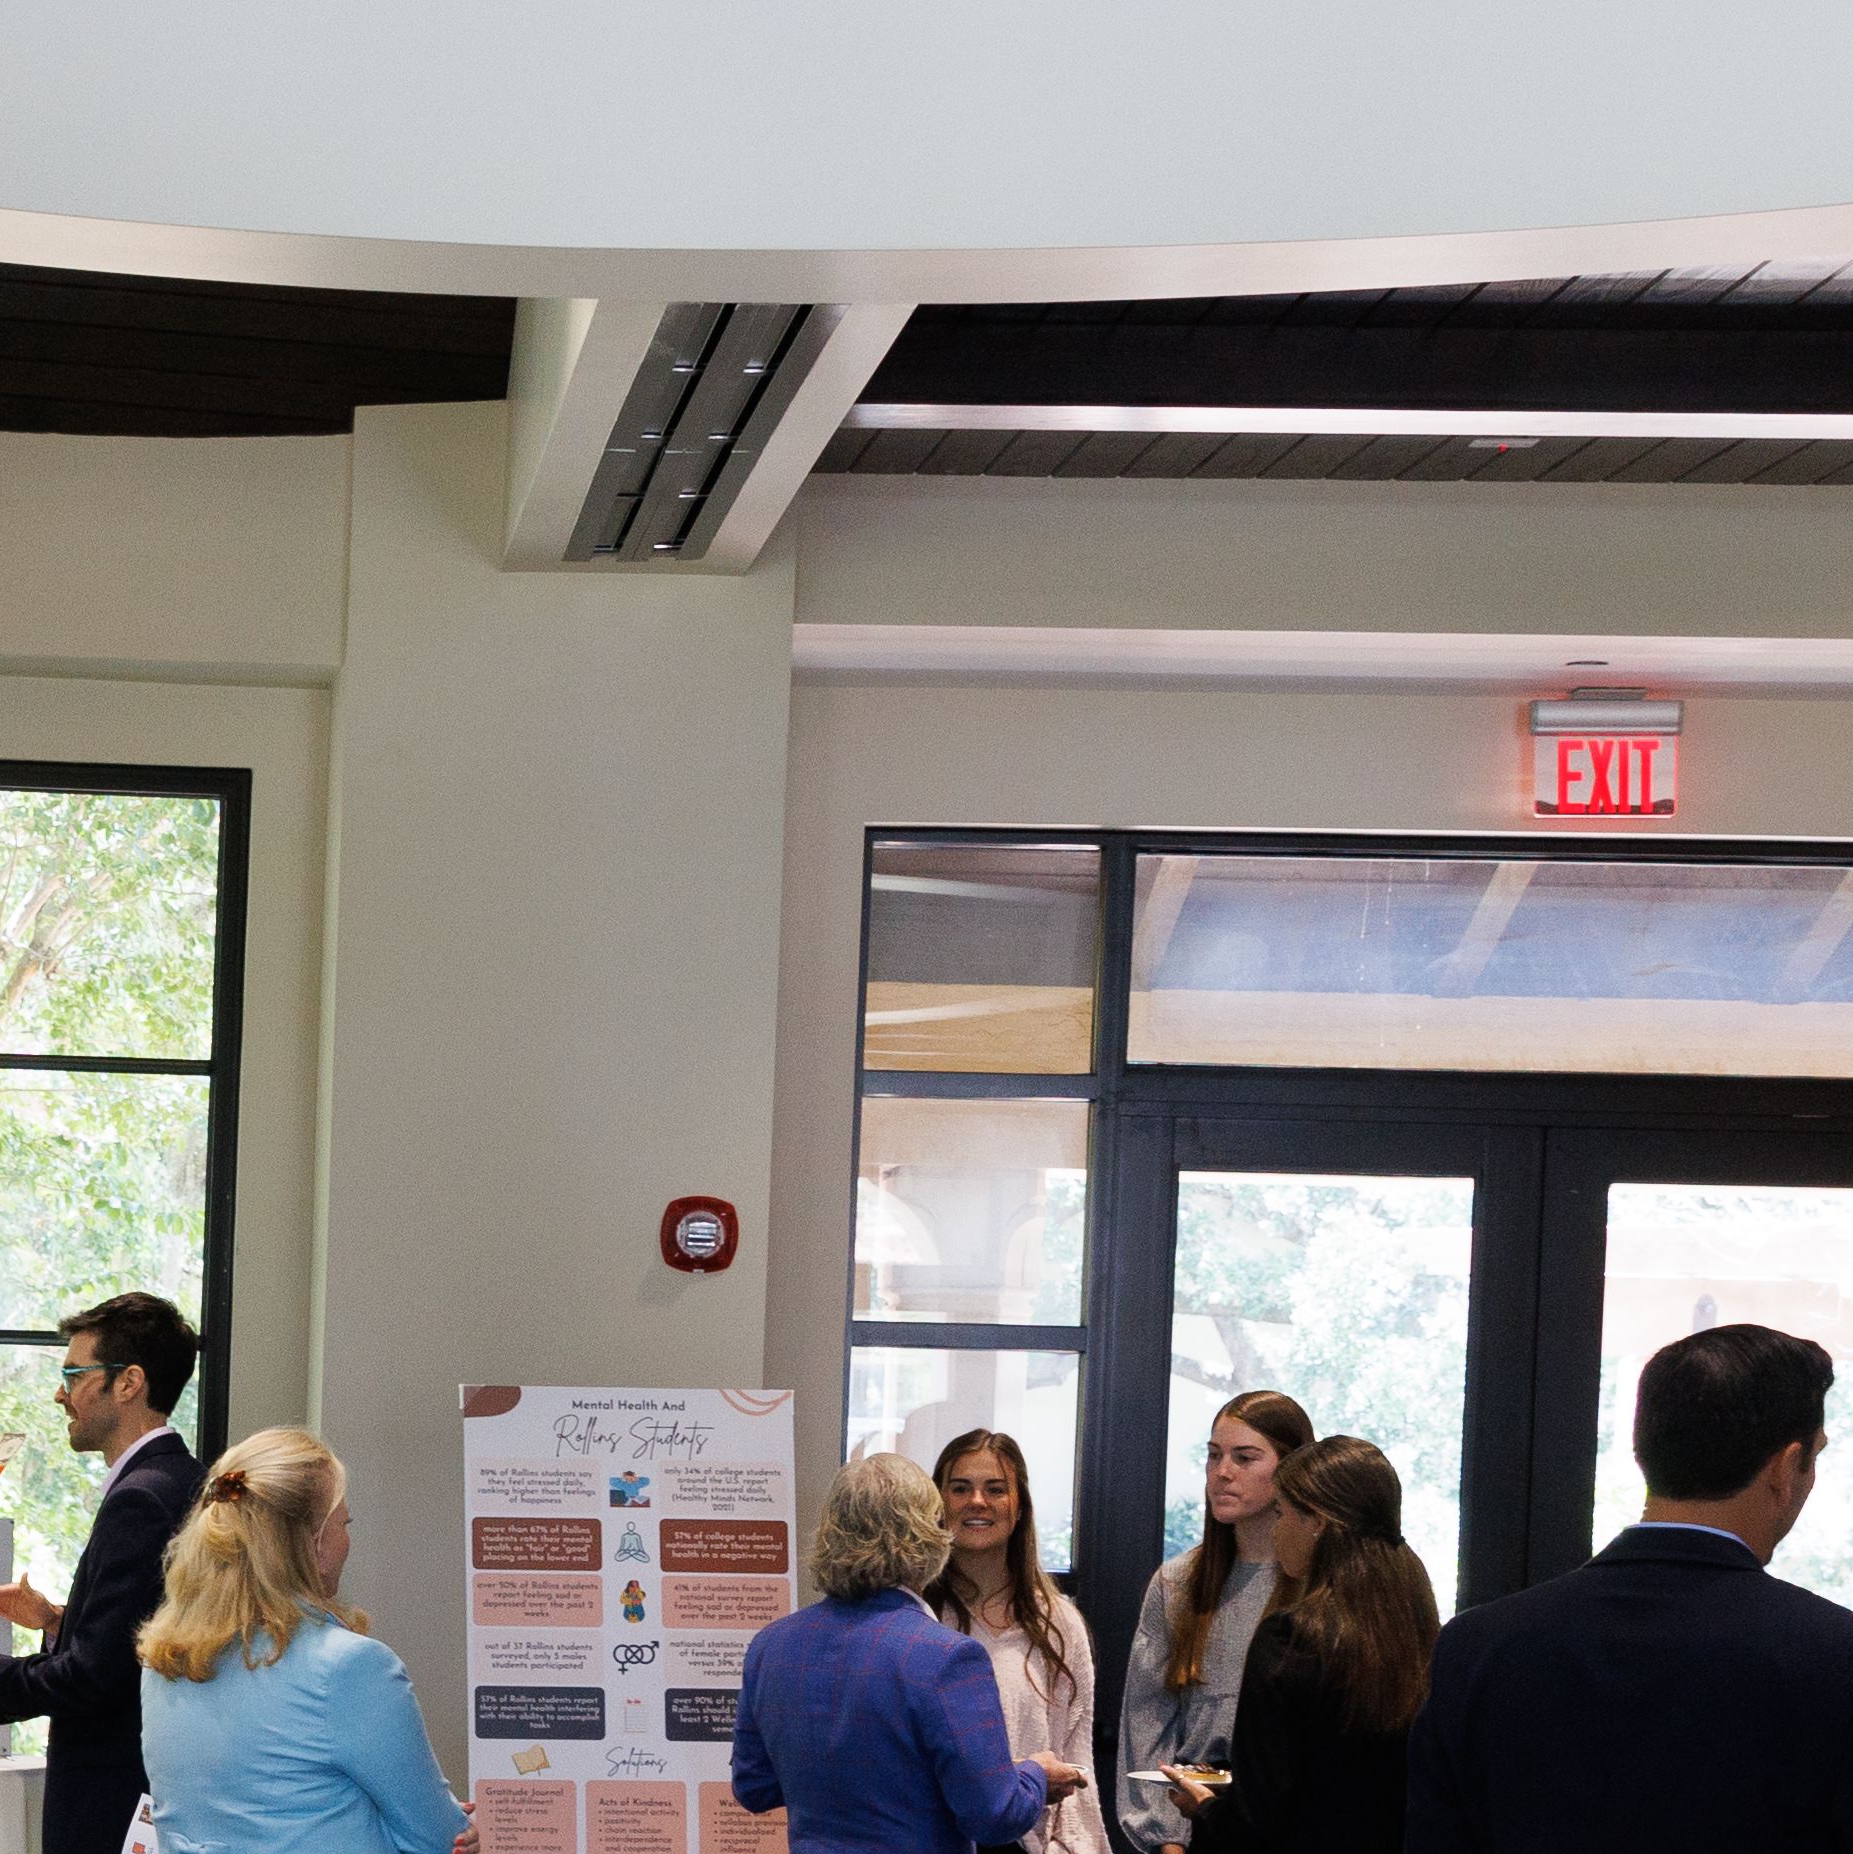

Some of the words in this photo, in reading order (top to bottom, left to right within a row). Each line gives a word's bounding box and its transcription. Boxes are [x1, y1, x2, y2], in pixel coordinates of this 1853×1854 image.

[1558, 739, 1662, 814] EXIT
[572, 1399, 613, 1410] Mental
[619, 1400, 657, 1411] Health
[662, 1401, 685, 1411] And
[553, 1414, 622, 1457] Rollins
[630, 1416, 714, 1460] Students
[500, 1468, 508, 1476] of
[542, 1469, 575, 1477] students
[665, 1467, 681, 1476] only
[703, 1467, 712, 1475] of
[715, 1467, 743, 1477] college
[746, 1468, 780, 1476] students
[488, 1478, 505, 1486] they
[527, 1478, 560, 1486] stressed
[677, 1476, 706, 1484] around
[710, 1476, 722, 1484] the
[743, 1478, 768, 1486] report
[478, 1488, 509, 1496] ranking
[512, 1488, 538, 1496] higher
[564, 1488, 595, 1496] feelings
[680, 1484, 708, 1494] feeling
[711, 1485, 743, 1494] stressed
[746, 1486, 766, 1495] daily
[521, 1496, 561, 1504] happiness
[672, 1494, 707, 1503] (Healthy
[711, 1494, 735, 1503] Minds
[694, 1531, 703, 1540] of
[706, 1532, 735, 1542] college
[738, 1532, 773, 1540] students
[731, 1541, 750, 1549] their
[753, 1542, 782, 1550] mental
[672, 1550, 699, 1558] health
[721, 1552, 757, 1561] negative
[692, 1583, 701, 1591] of
[704, 1584, 739, 1592] students
[742, 1584, 761, 1592] from
[674, 1602, 703, 1611] feeling
[707, 1602, 721, 1610] sad
[736, 1603, 779, 1611] depressed
[718, 1613, 736, 1621] past
[502, 1642, 510, 1650] of
[526, 1642, 554, 1650] Rollins
[531, 1662, 584, 1670] participated
[605, 1746, 667, 1777] Solutions
[485, 1787, 528, 1796] Gratitude
[532, 1788, 564, 1796] Journal
[599, 1798, 618, 1807] Acts
[620, 1797, 630, 1806] of
[633, 1799, 672, 1807] Kindness
[604, 1808, 649, 1816] intentional
[650, 1808, 680, 1818] activity
